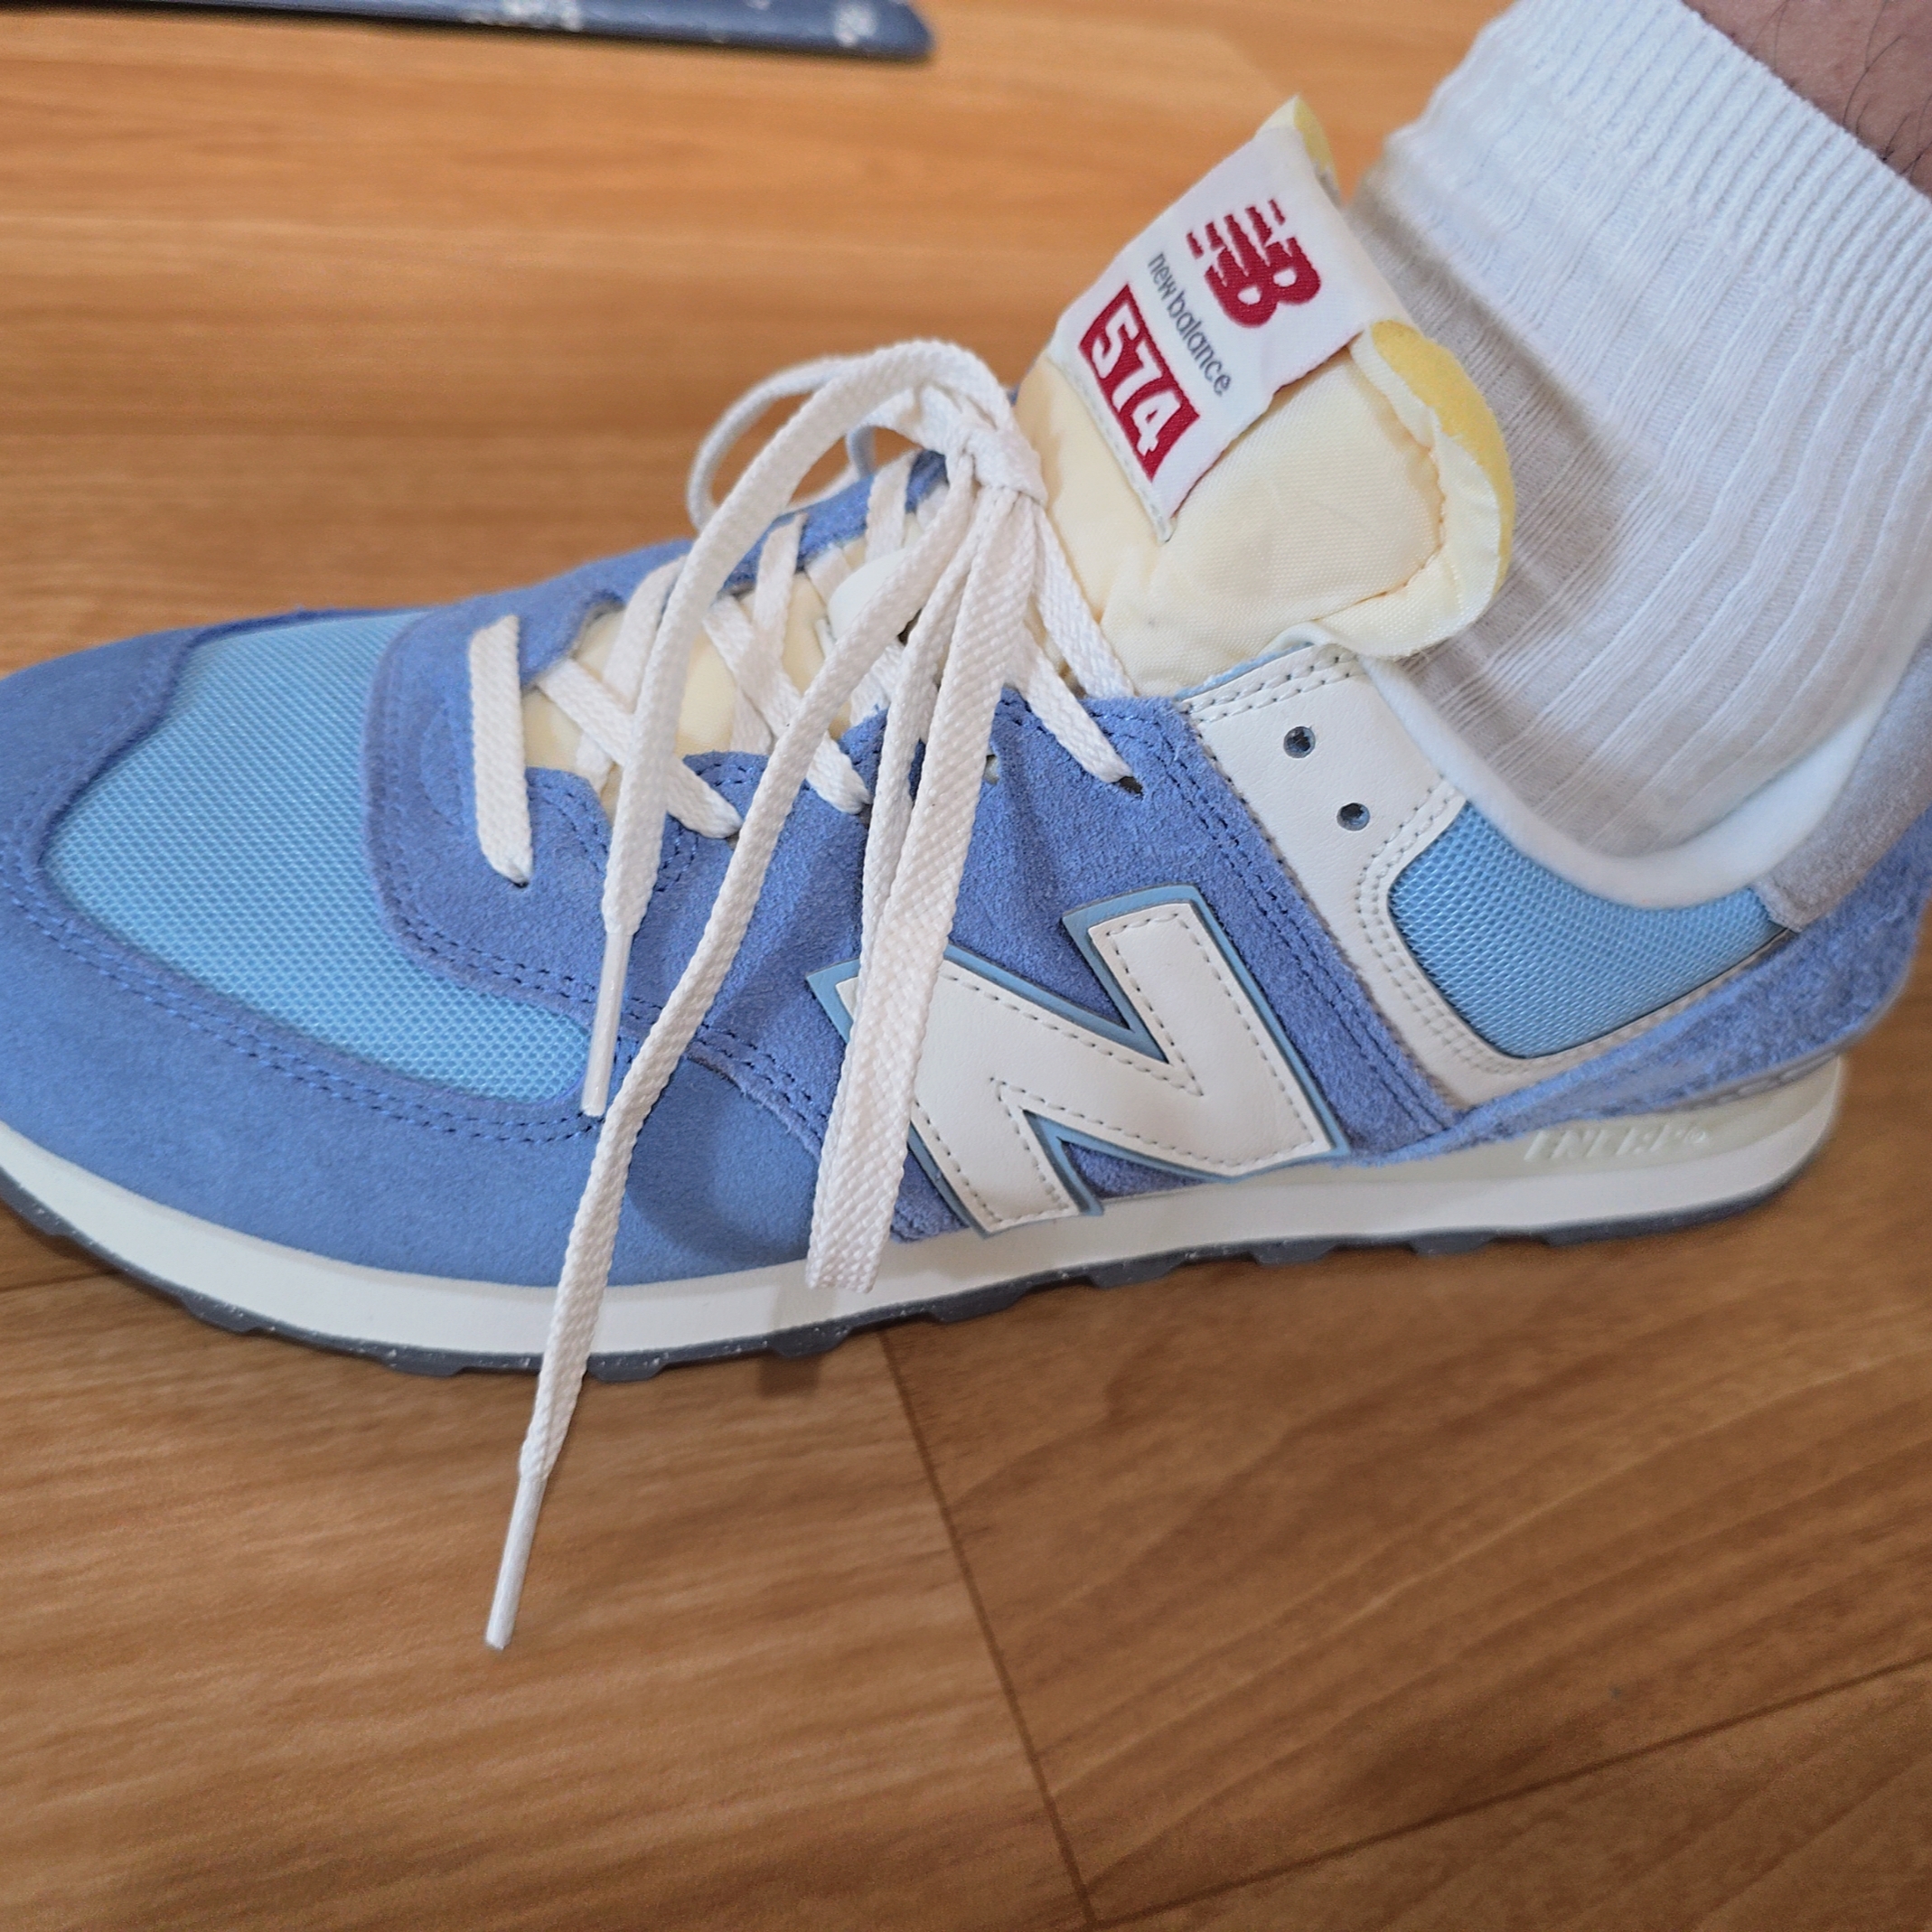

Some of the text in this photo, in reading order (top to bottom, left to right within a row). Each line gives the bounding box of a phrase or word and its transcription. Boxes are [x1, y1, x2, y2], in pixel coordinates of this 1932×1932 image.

[1091, 304, 1182, 456] 574
[1148, 251, 1232, 398] new balance
[821, 890, 1340, 1233] N
